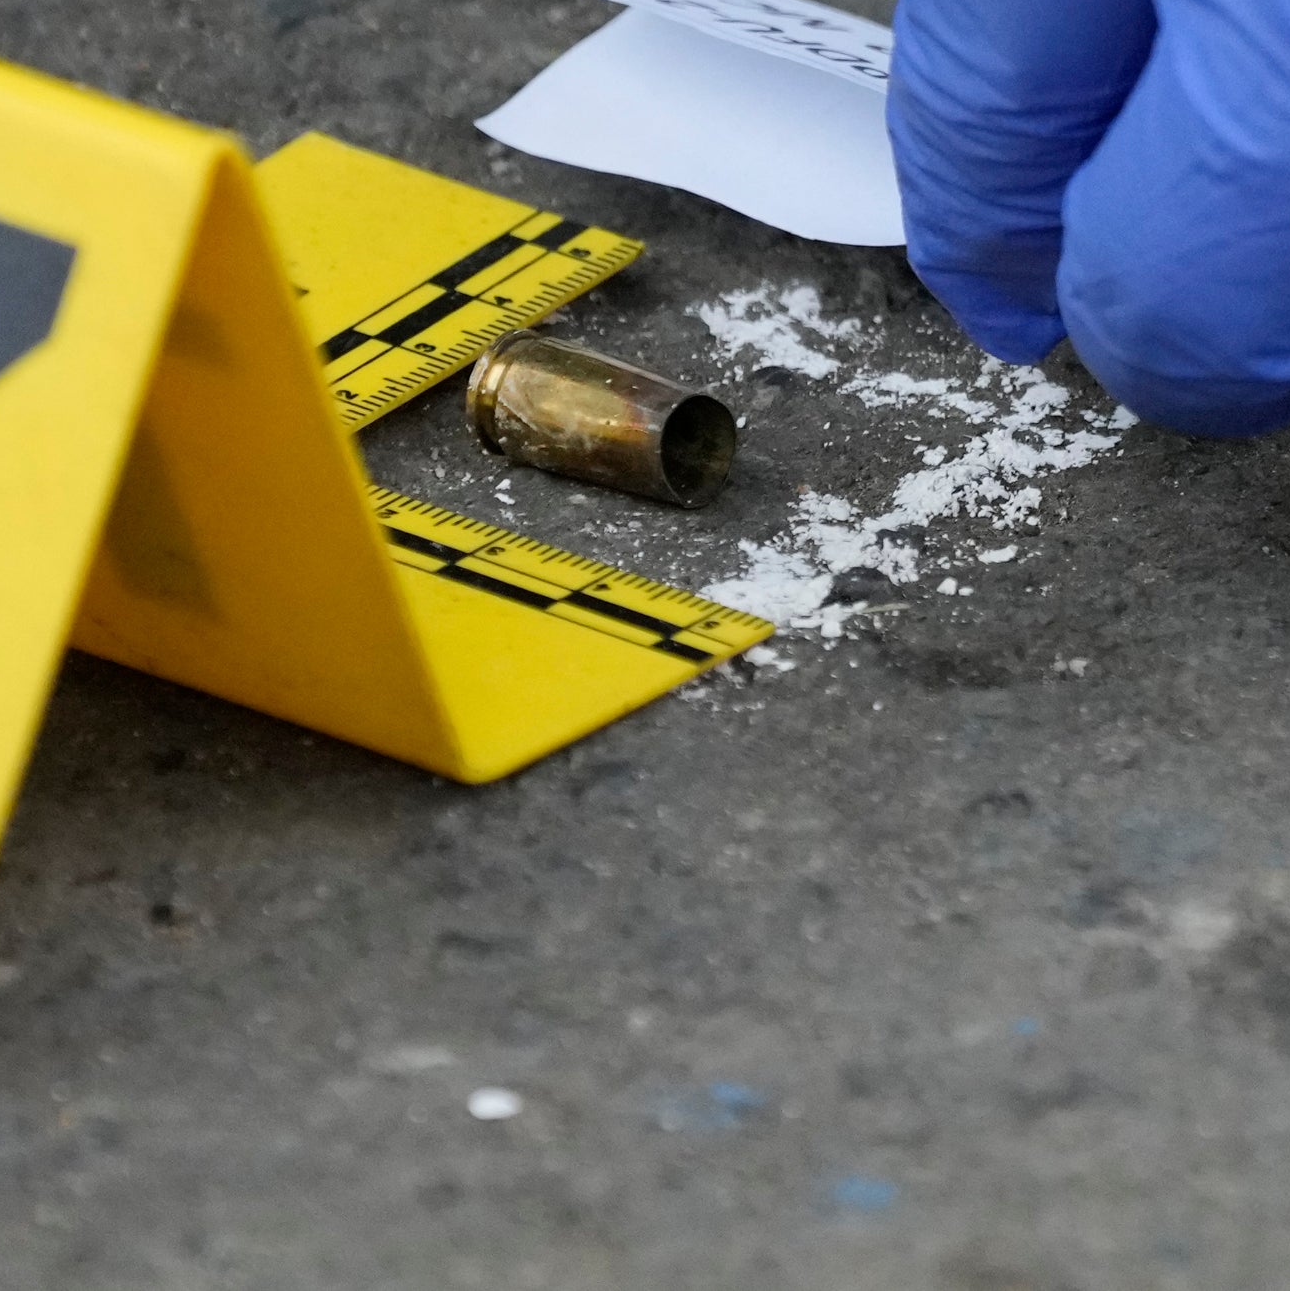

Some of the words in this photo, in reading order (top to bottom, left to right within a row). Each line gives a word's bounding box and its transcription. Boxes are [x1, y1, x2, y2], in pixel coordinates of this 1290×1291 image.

[336, 389, 359, 401] 2
[415, 343, 436, 354] 3
[493, 296, 512, 307] 4
[570, 248, 591, 260] 5
